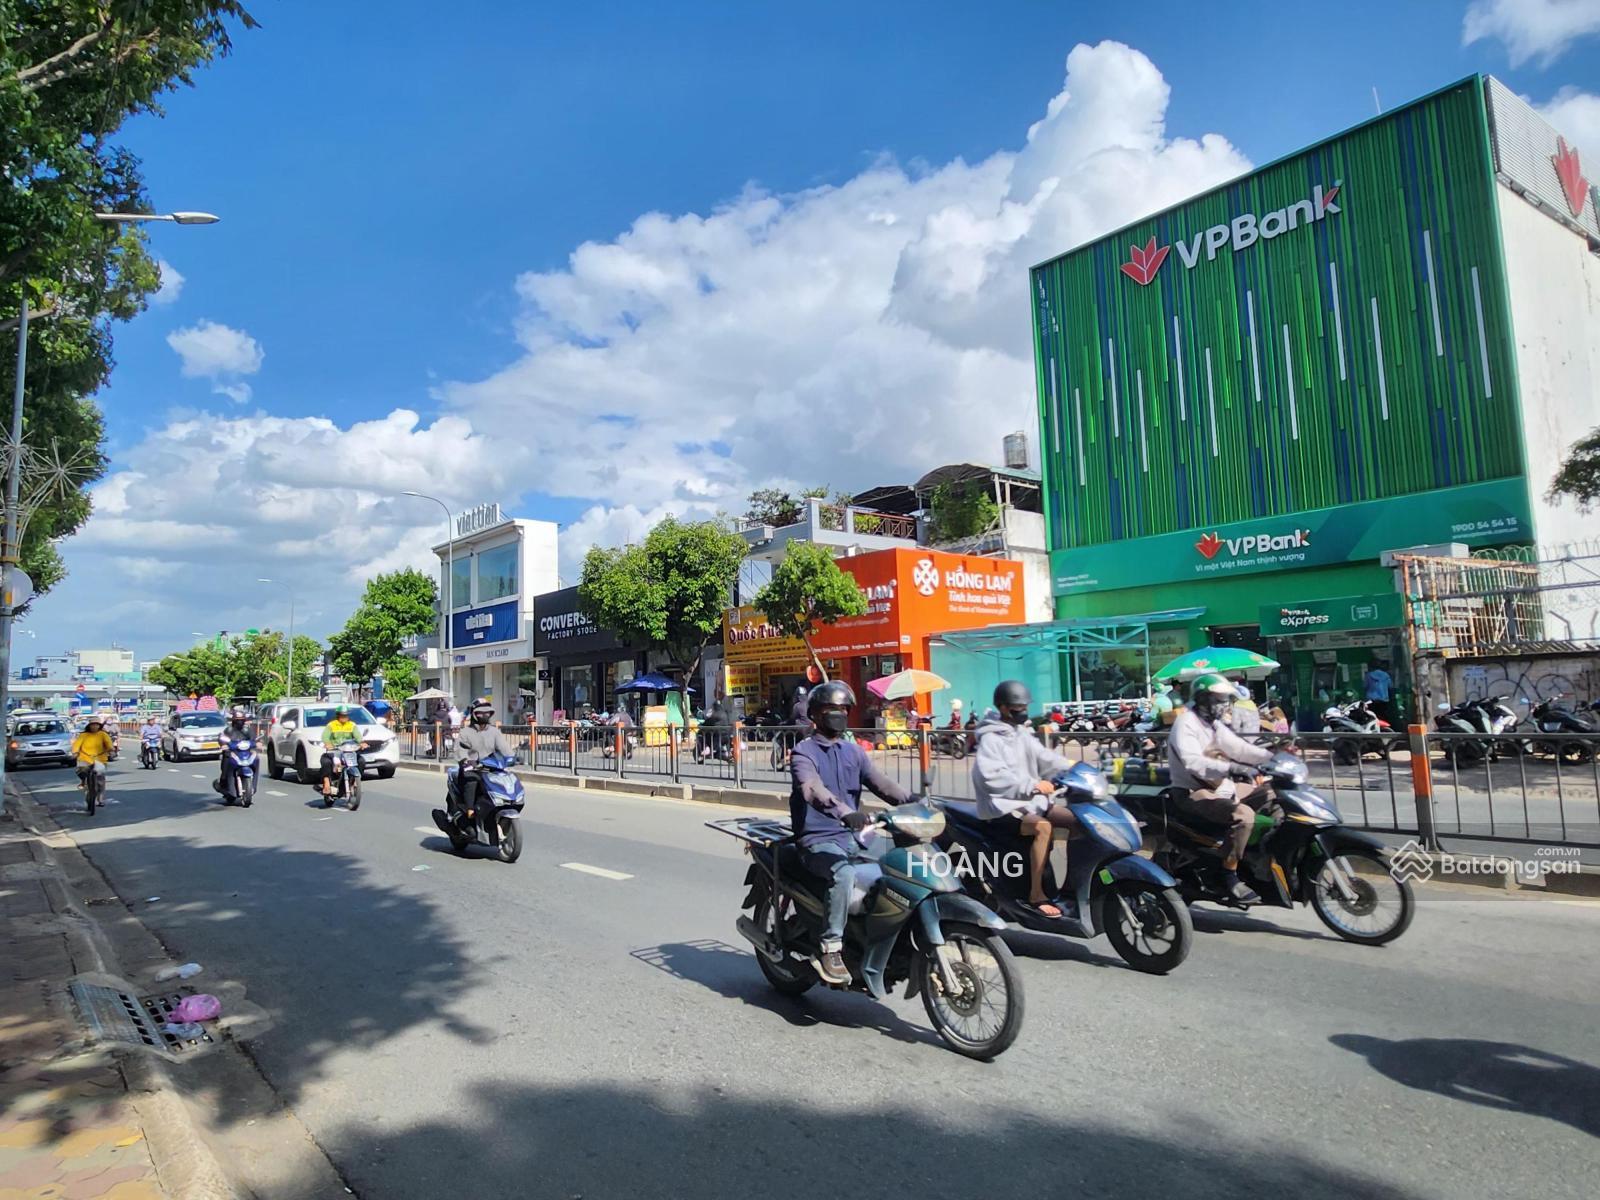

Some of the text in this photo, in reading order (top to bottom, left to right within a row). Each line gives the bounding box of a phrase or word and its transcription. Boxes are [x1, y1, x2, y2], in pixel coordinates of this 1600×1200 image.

[1175, 179, 1343, 270] VPBank
[1451, 517, 1518, 533] 1900 54 54 15
[1226, 529, 1310, 556] VPBank
[1220, 560, 1236, 570] Việt
[1237, 558, 1256, 567] Nam
[1257, 555, 1278, 565] thịnh
[1278, 552, 1305, 563] vượng
[945, 565, 1012, 592] HỒNG LAM
[540, 610, 593, 632] CONVERSE
[547, 628, 573, 640] FACTORY
[729, 621, 758, 645] Quốc
